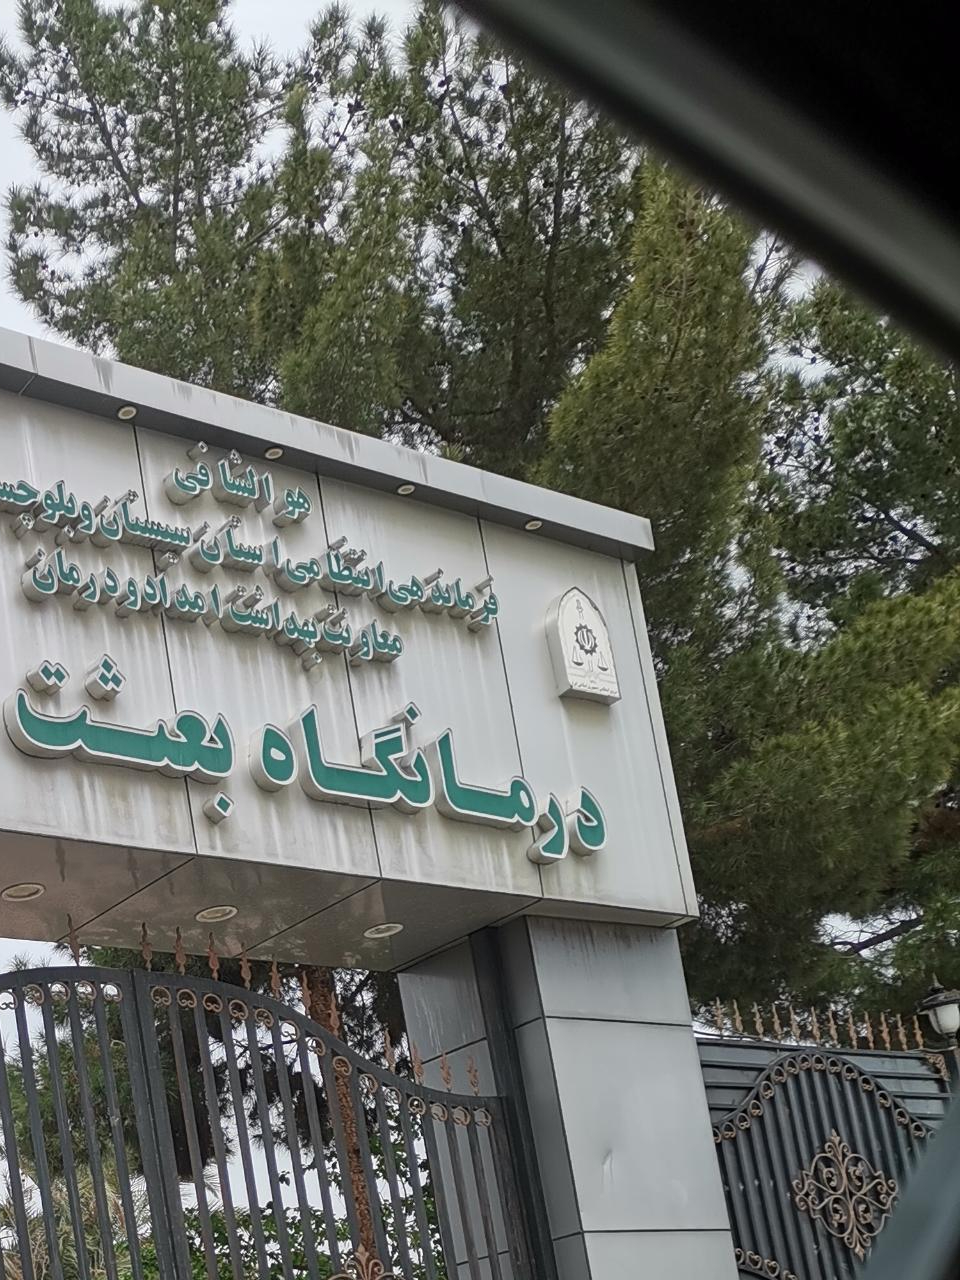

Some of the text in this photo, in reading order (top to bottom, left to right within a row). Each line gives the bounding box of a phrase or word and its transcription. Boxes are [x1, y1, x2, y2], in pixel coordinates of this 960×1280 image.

[172, 441, 312, 520] هو الشافی
[78, 501, 97, 535] و
[98, 489, 193, 566] سیستان
[199, 515, 282, 569] استان
[31, 546, 120, 603] درمان
[285, 536, 386, 592] انتظامی
[143, 571, 224, 619] امداد
[228, 584, 323, 664] بهداشت
[388, 568, 500, 626] فرماندهی
[321, 602, 405, 661] معاونت
[10, 653, 608, 862] درمانگاه بعثت
